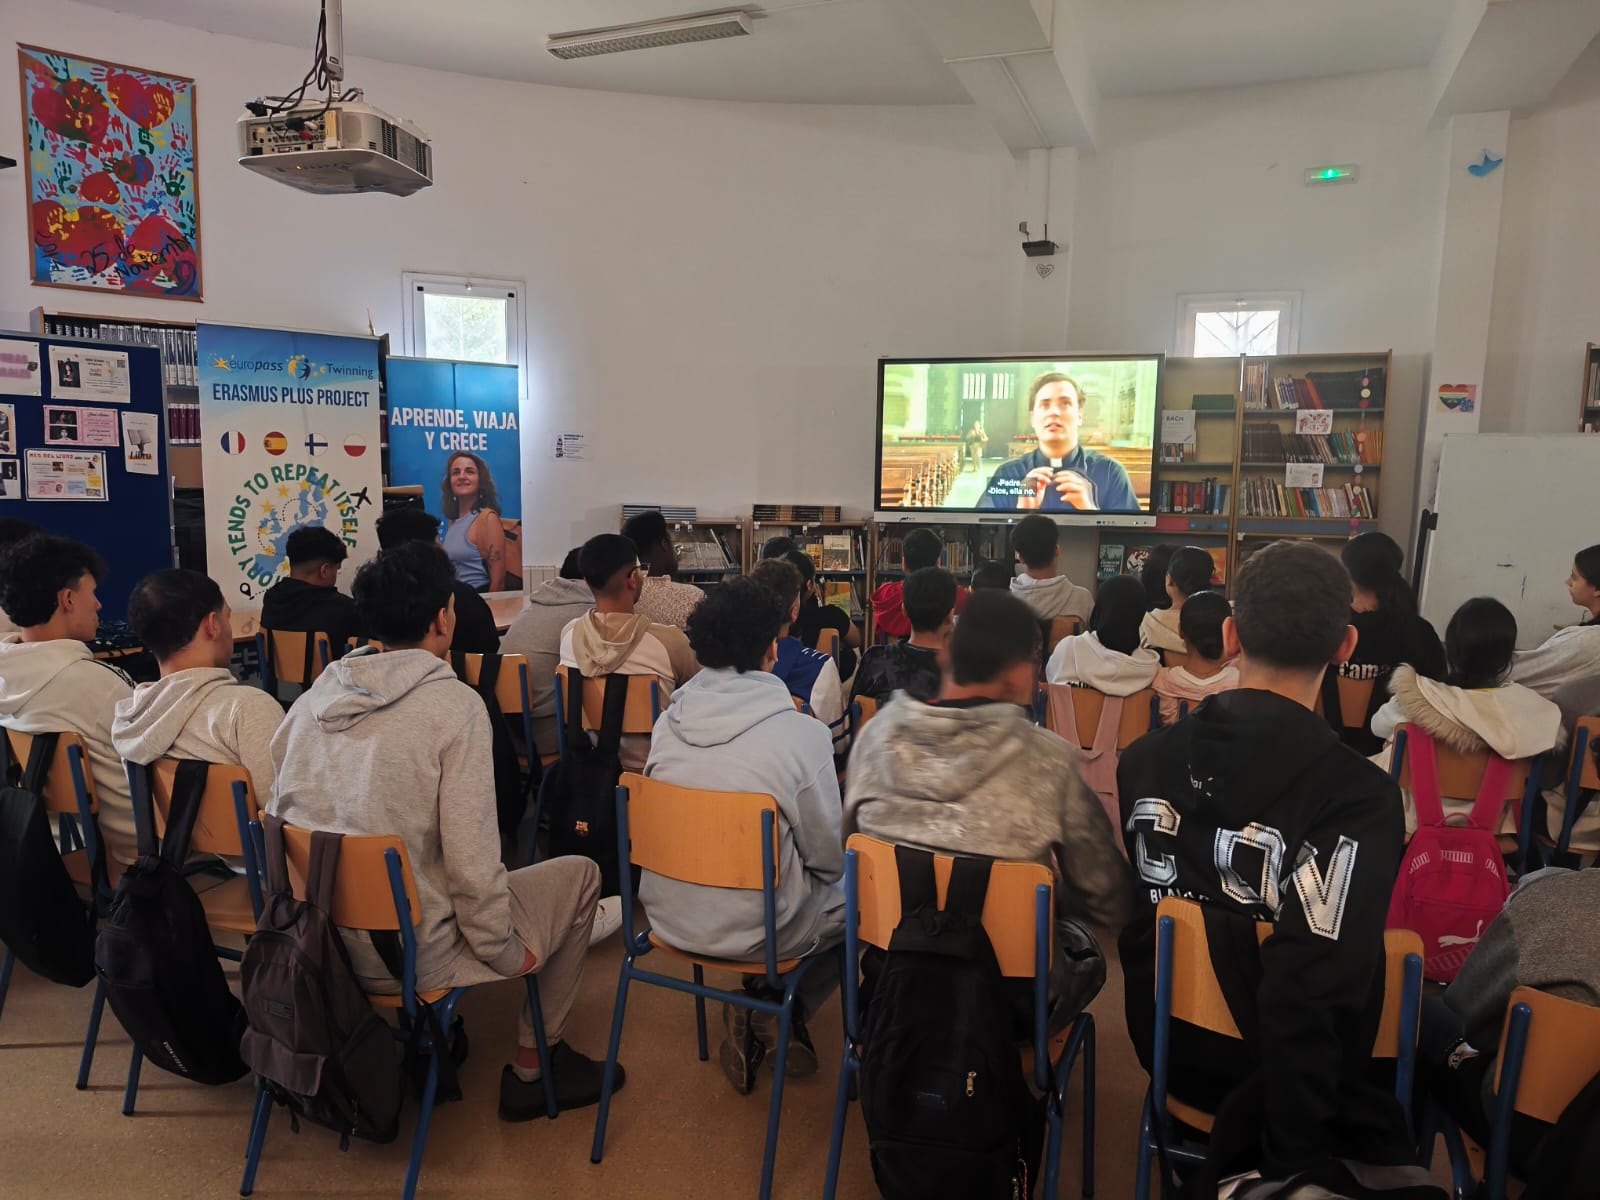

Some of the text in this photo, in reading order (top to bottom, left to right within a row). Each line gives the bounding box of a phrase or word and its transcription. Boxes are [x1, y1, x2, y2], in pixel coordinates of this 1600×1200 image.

[229, 358, 284, 373] europass
[325, 363, 374, 380] Twinning
[213, 383, 369, 407] ERASMUS PLUS PROJECT
[391, 407, 518, 431] APRENDE, VIAJA
[424, 431, 488, 451] Y CRECE
[227, 463, 359, 556] TENDS TO REPEAT ITSELF
